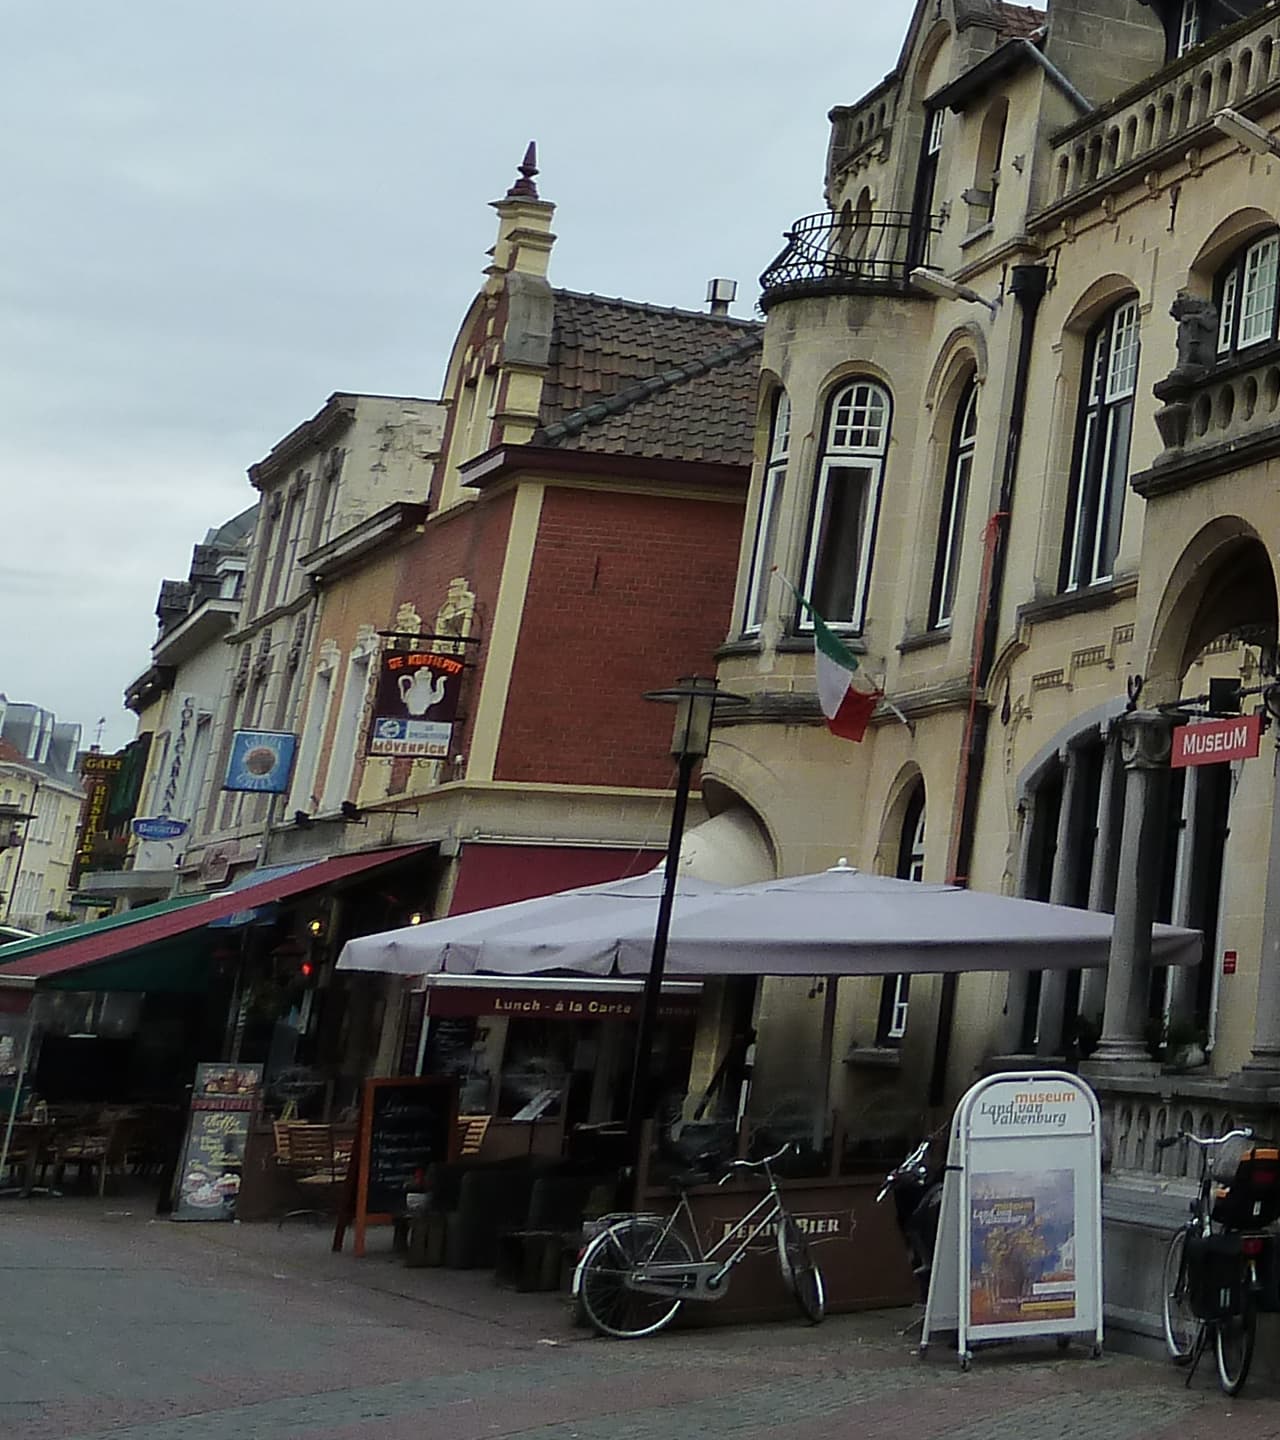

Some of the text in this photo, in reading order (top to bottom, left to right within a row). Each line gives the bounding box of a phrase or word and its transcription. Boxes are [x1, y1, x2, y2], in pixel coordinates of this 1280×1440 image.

[1183, 726, 1247, 756] MUSEUM
[139, 823, 181, 834] Bavaria
[495, 998, 541, 1011] Lunch
[569, 1001, 583, 1012] la
[588, 1000, 632, 1013] Carte
[1015, 1092, 1076, 1104] museum
[980, 1101, 1044, 1115] Land van
[991, 1111, 1067, 1127] Valkenburg
